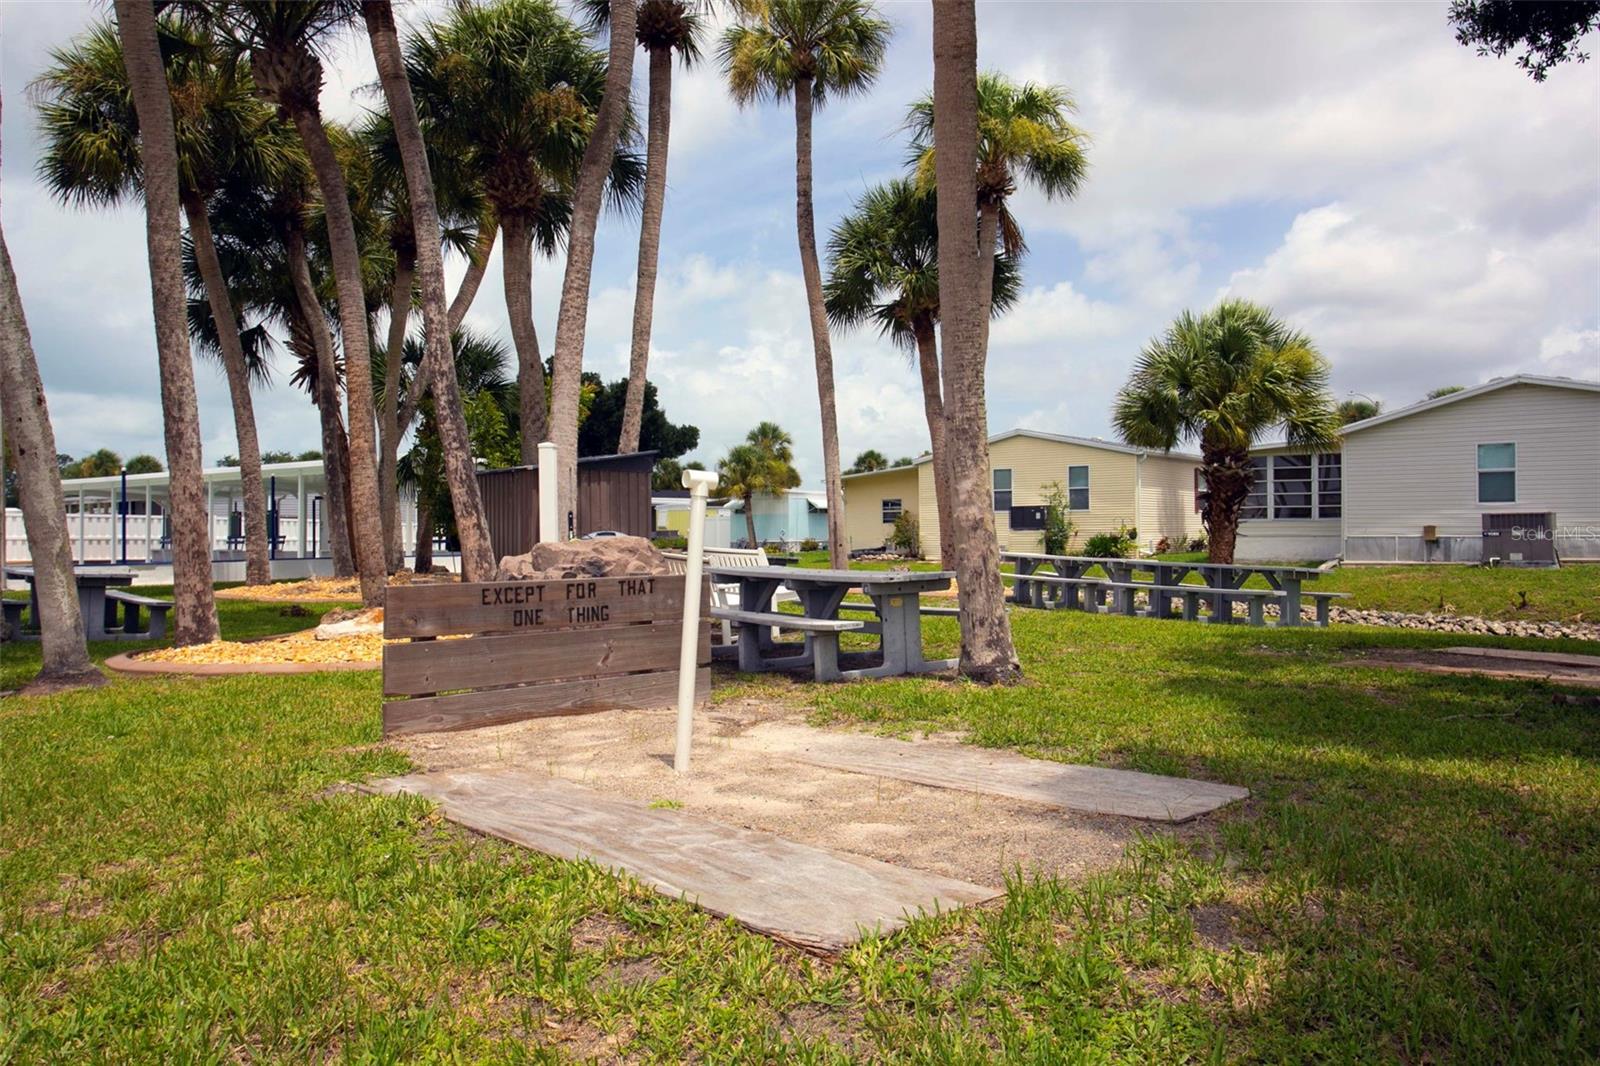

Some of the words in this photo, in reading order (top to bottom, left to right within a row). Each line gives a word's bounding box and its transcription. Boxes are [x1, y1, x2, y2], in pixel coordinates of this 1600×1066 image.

[482, 585, 545, 605] EXCEPT
[566, 582, 597, 600] FOR
[618, 579, 656, 596] THAT
[513, 609, 544, 627] ONE
[568, 605, 609, 624] THING
